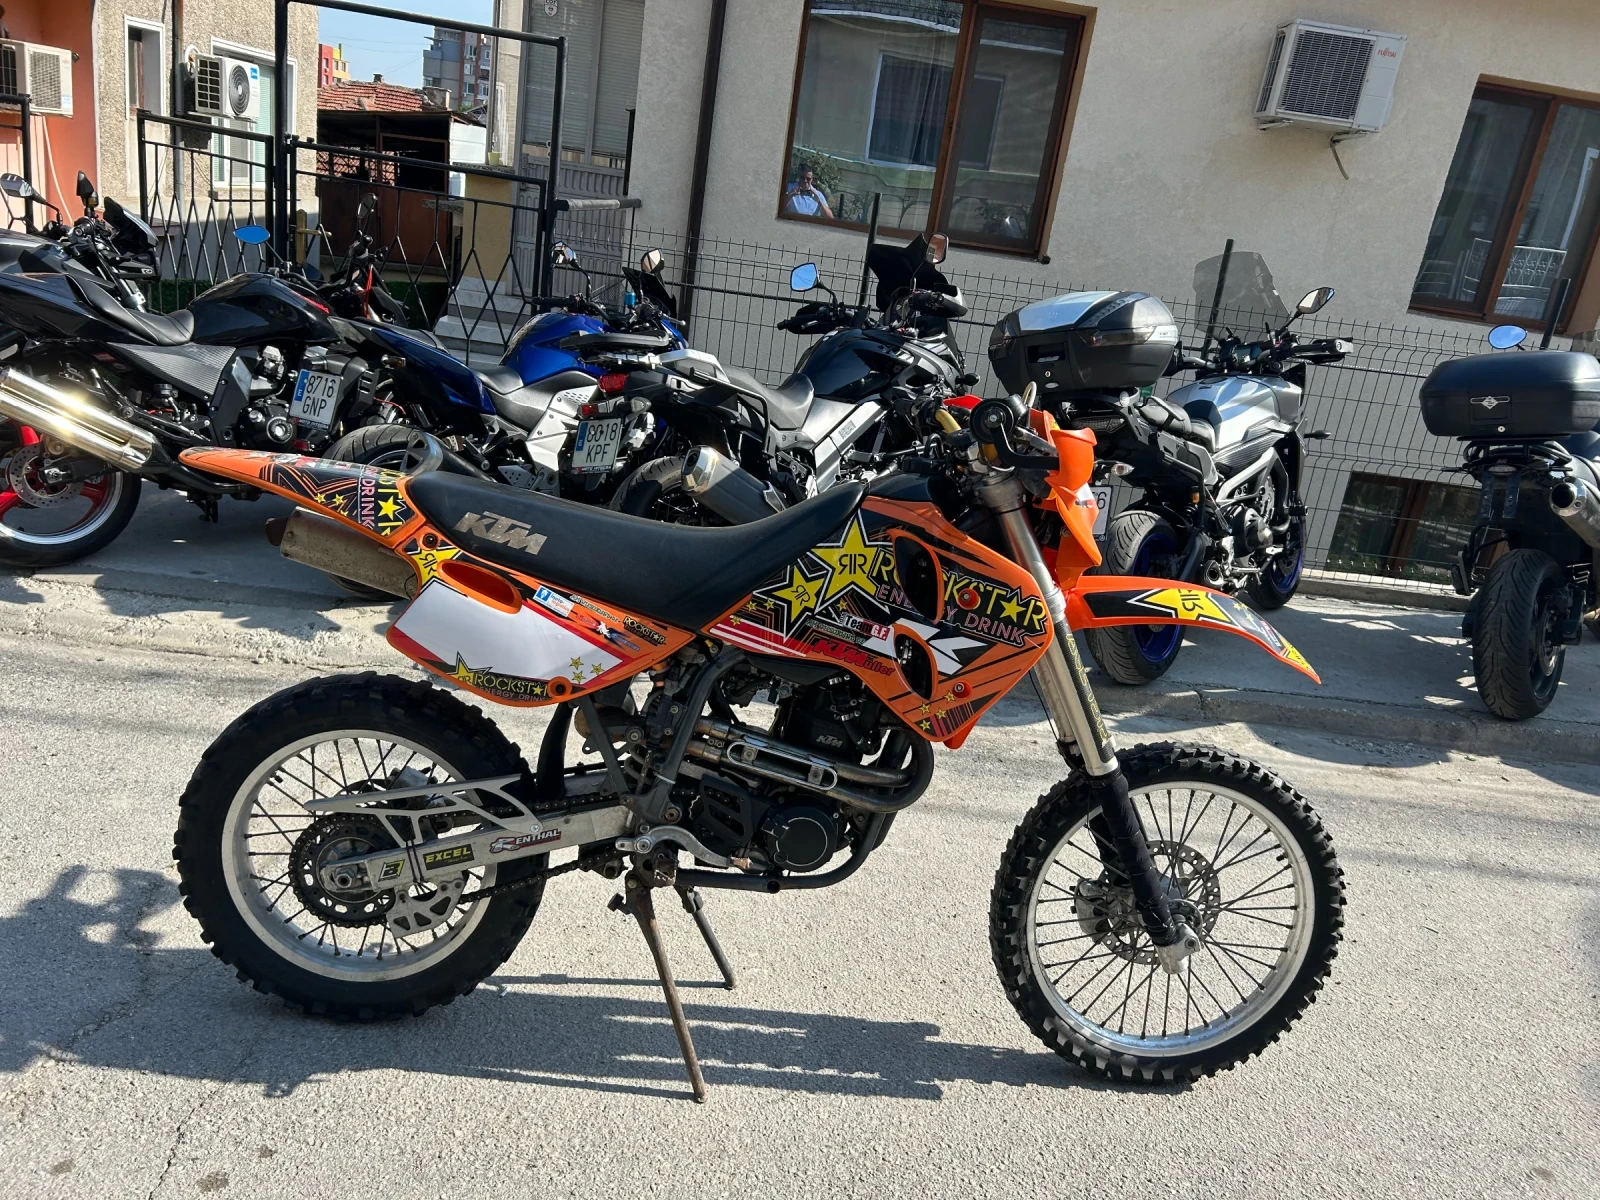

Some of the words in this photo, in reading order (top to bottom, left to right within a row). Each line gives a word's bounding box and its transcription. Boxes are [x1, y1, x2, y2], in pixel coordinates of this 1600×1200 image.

[1377, 48, 1397, 57] FUJITSU
[306, 375, 336, 398] 8716
[302, 396, 327, 417] GNP
[587, 422, 618, 442] 8018
[585, 444, 610, 463] KPF
[361, 478, 375, 528] DRINK
[452, 510, 548, 555] KTM
[878, 584, 958, 621] ENY
[965, 612, 1025, 642] DRINK
[845, 615, 871, 636] Team
[816, 735, 843, 748] KTM
[425, 847, 471, 863] EXCEL
